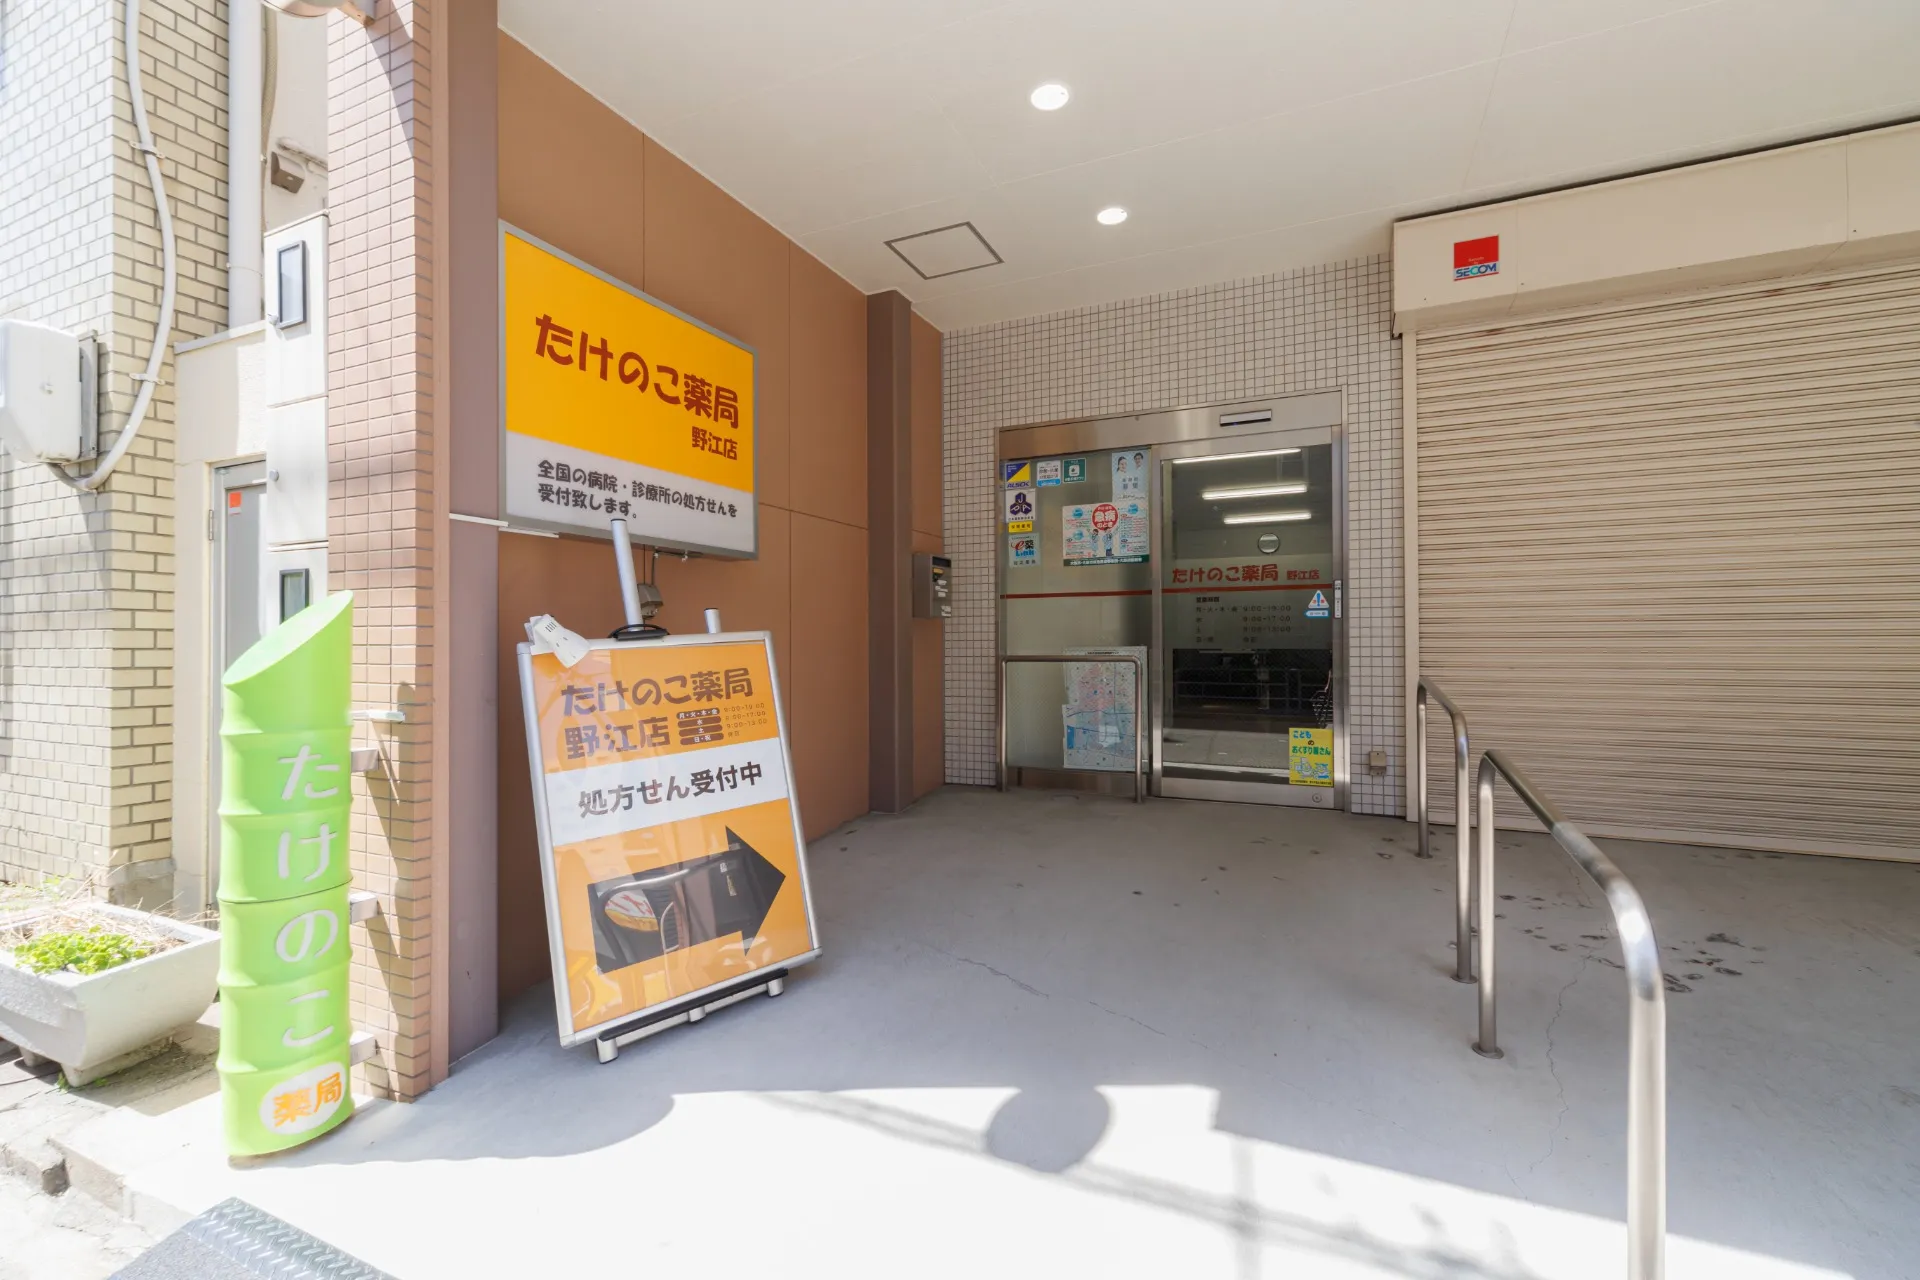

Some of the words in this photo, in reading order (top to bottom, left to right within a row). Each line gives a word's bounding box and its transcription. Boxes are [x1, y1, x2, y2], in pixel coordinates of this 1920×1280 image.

[1456, 263, 1497, 278] SECOM
[535, 313, 739, 429] たけのこ薬局
[691, 425, 738, 460] 野江店
[537, 459, 738, 518] 全国の病院・診療所の処方せんを
[537, 482, 637, 519] 受付致します。
[1172, 563, 1279, 584] たけのこ薬局
[1286, 569, 1320, 581] 野江店
[561, 667, 754, 717] たけのこ薬局
[564, 716, 671, 760] 野江店
[1293, 730, 1311, 739] こども
[578, 760, 763, 819] 処方せん受付中
[276, 744, 341, 1049] たけのこ
[273, 1071, 342, 1128] 薬局
